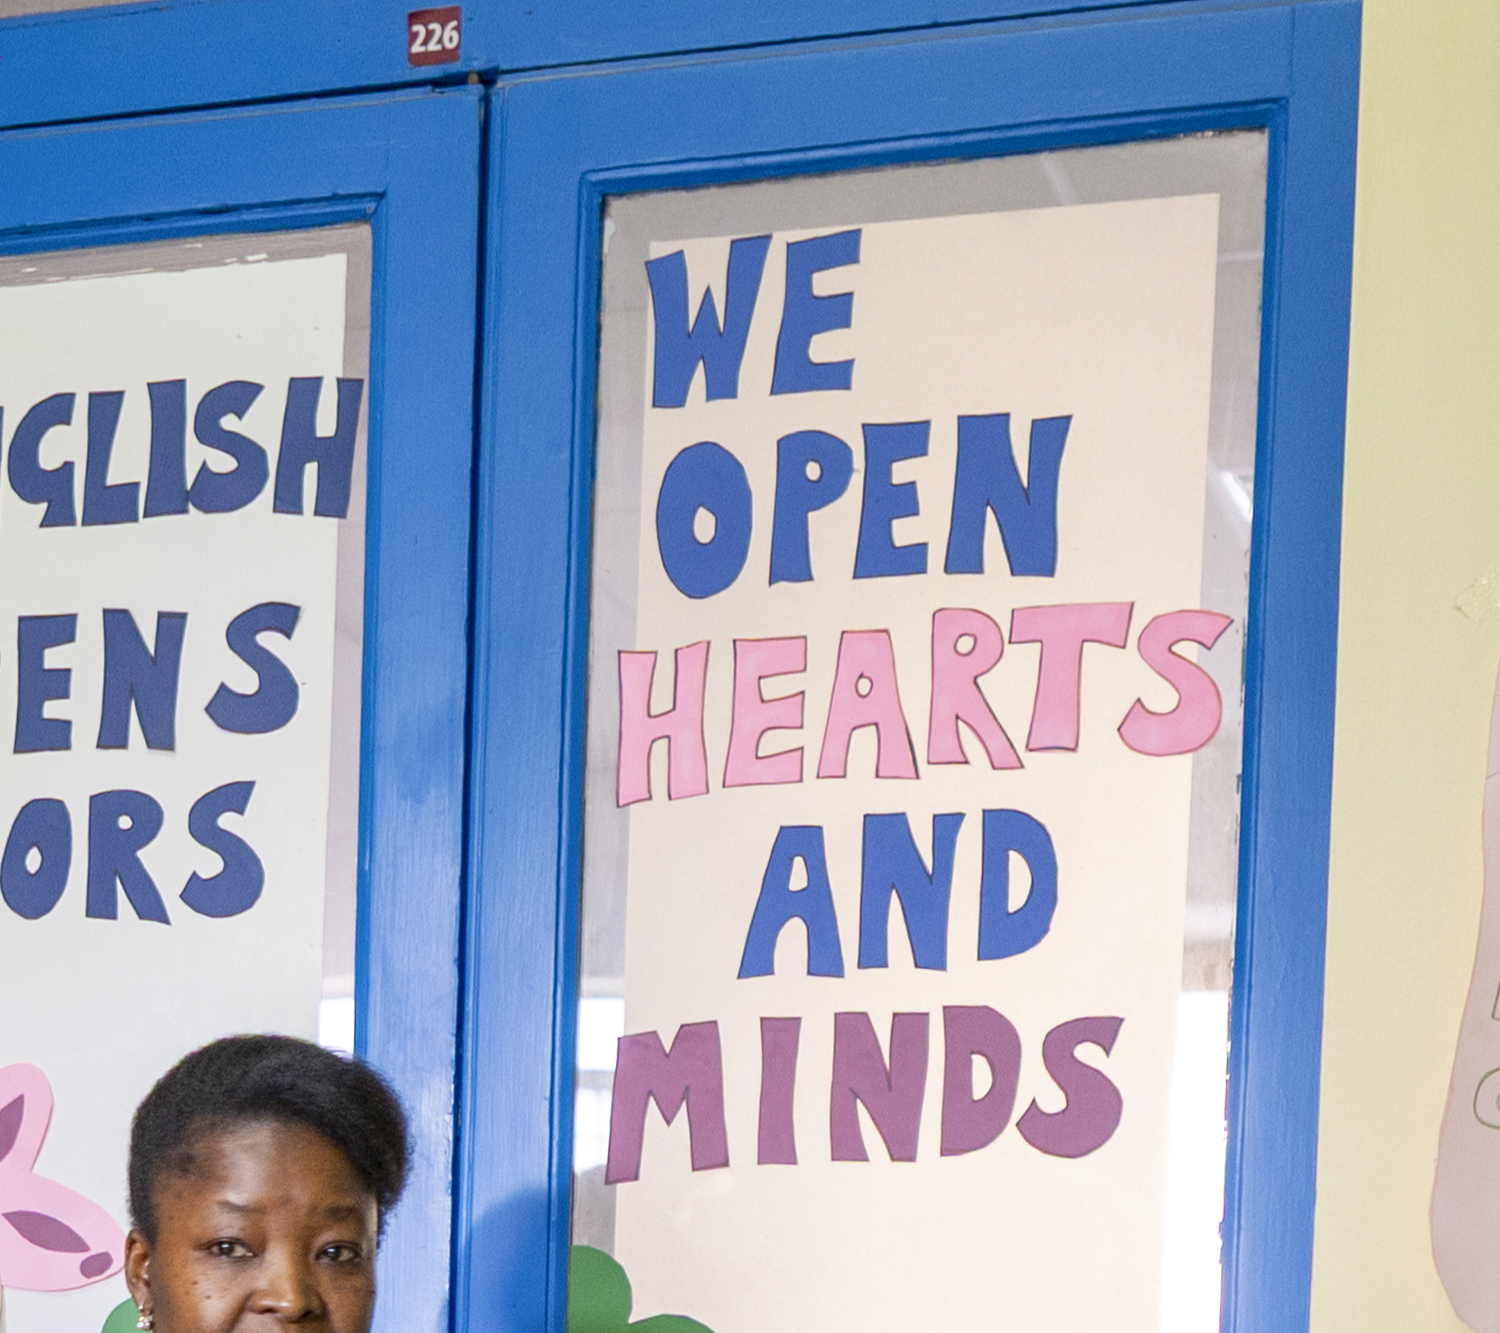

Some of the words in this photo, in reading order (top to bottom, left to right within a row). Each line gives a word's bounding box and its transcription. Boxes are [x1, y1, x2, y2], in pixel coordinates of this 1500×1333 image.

[410, 20, 460, 54] 226
[645, 228, 862, 409] WE
[655, 412, 1074, 599] OPEN
[615, 601, 1236, 808] HEARTS
[736, 808, 1059, 980] AND
[603, 1005, 1125, 1185] MINDS
